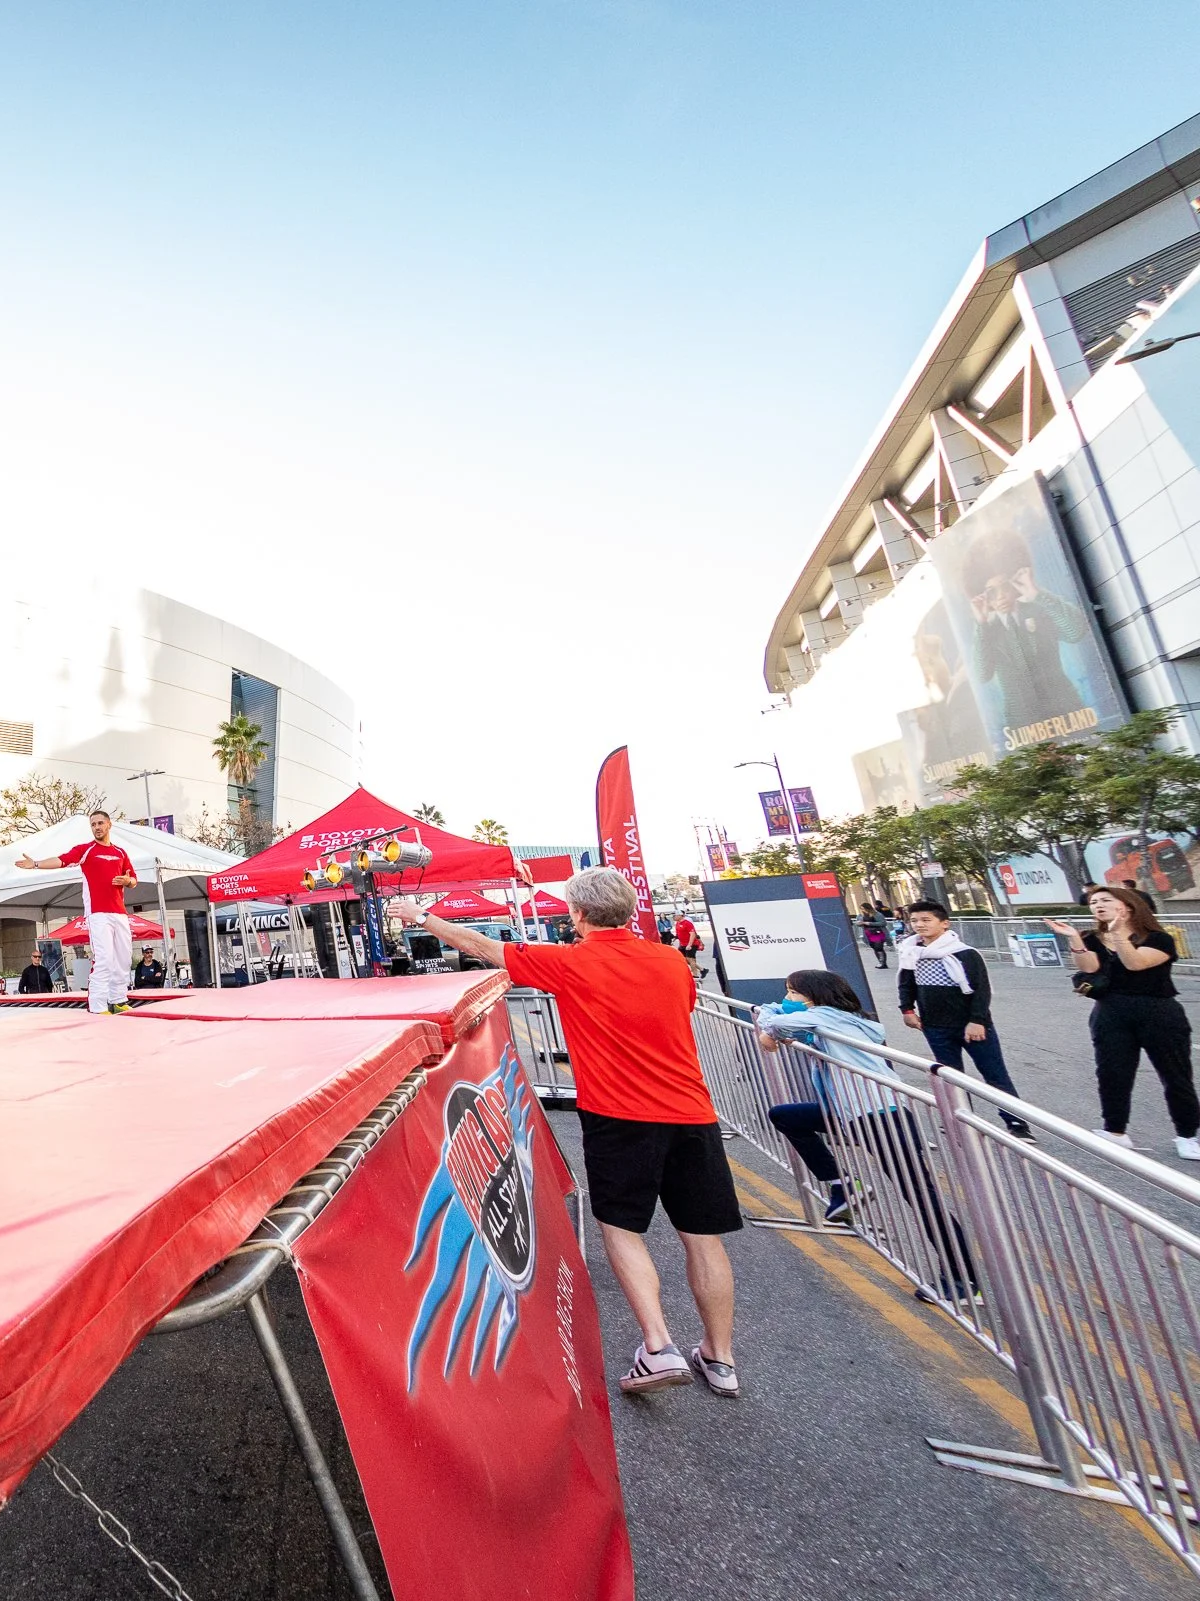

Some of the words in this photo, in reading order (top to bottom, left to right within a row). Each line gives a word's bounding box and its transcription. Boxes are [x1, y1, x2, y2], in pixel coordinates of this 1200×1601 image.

[1003, 707, 1098, 750] SLUMBERLAND
[318, 828, 387, 841] TOYOTA
[623, 815, 650, 913] FESTIVAL
[218, 874, 249, 884] TOYOTA
[1016, 870, 1053, 886] TUNDRA
[211, 882, 239, 891] SPORTS
[224, 886, 258, 896] FESTIVAL
[725, 927, 747, 936] US
[752, 937, 807, 945] SNOWBOARD
[486, 1201, 509, 1247] ALL
